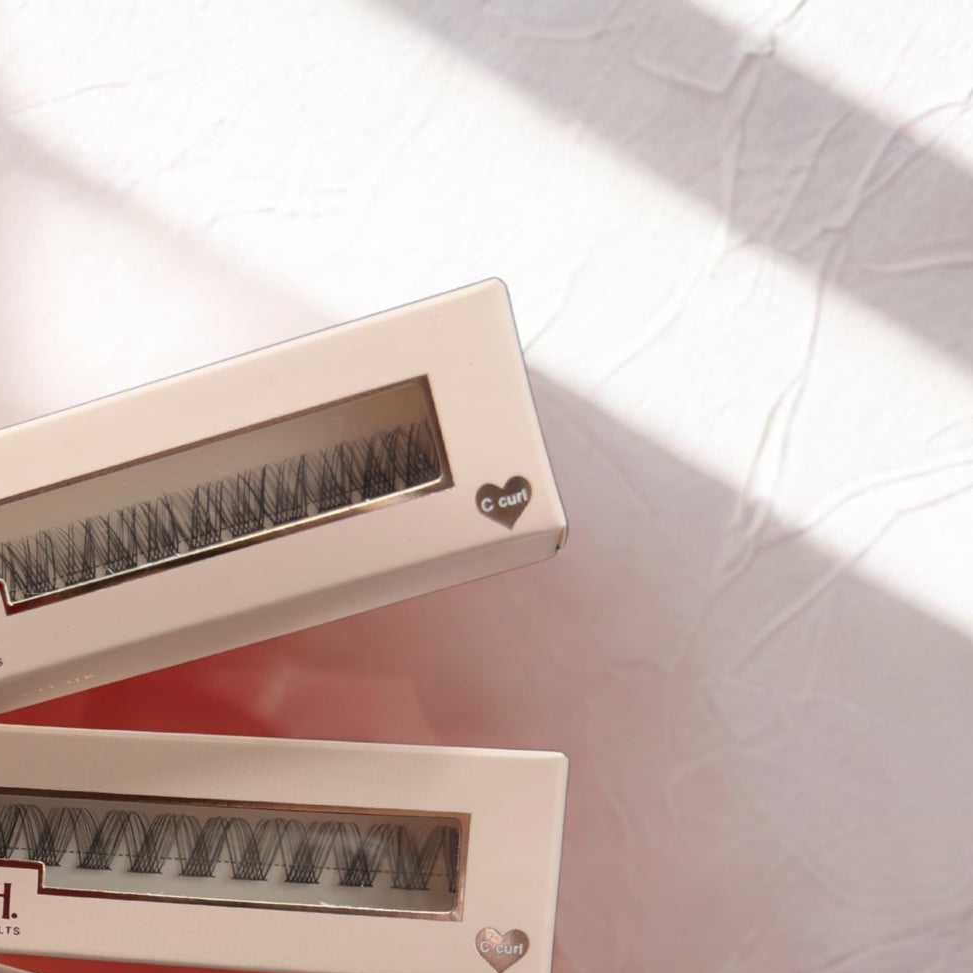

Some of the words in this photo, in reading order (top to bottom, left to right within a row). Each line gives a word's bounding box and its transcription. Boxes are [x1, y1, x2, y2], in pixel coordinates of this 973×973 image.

[480, 497, 495, 513] C
[498, 488, 528, 509] curl
[479, 941, 491, 954] C
[496, 943, 524, 956] curl
